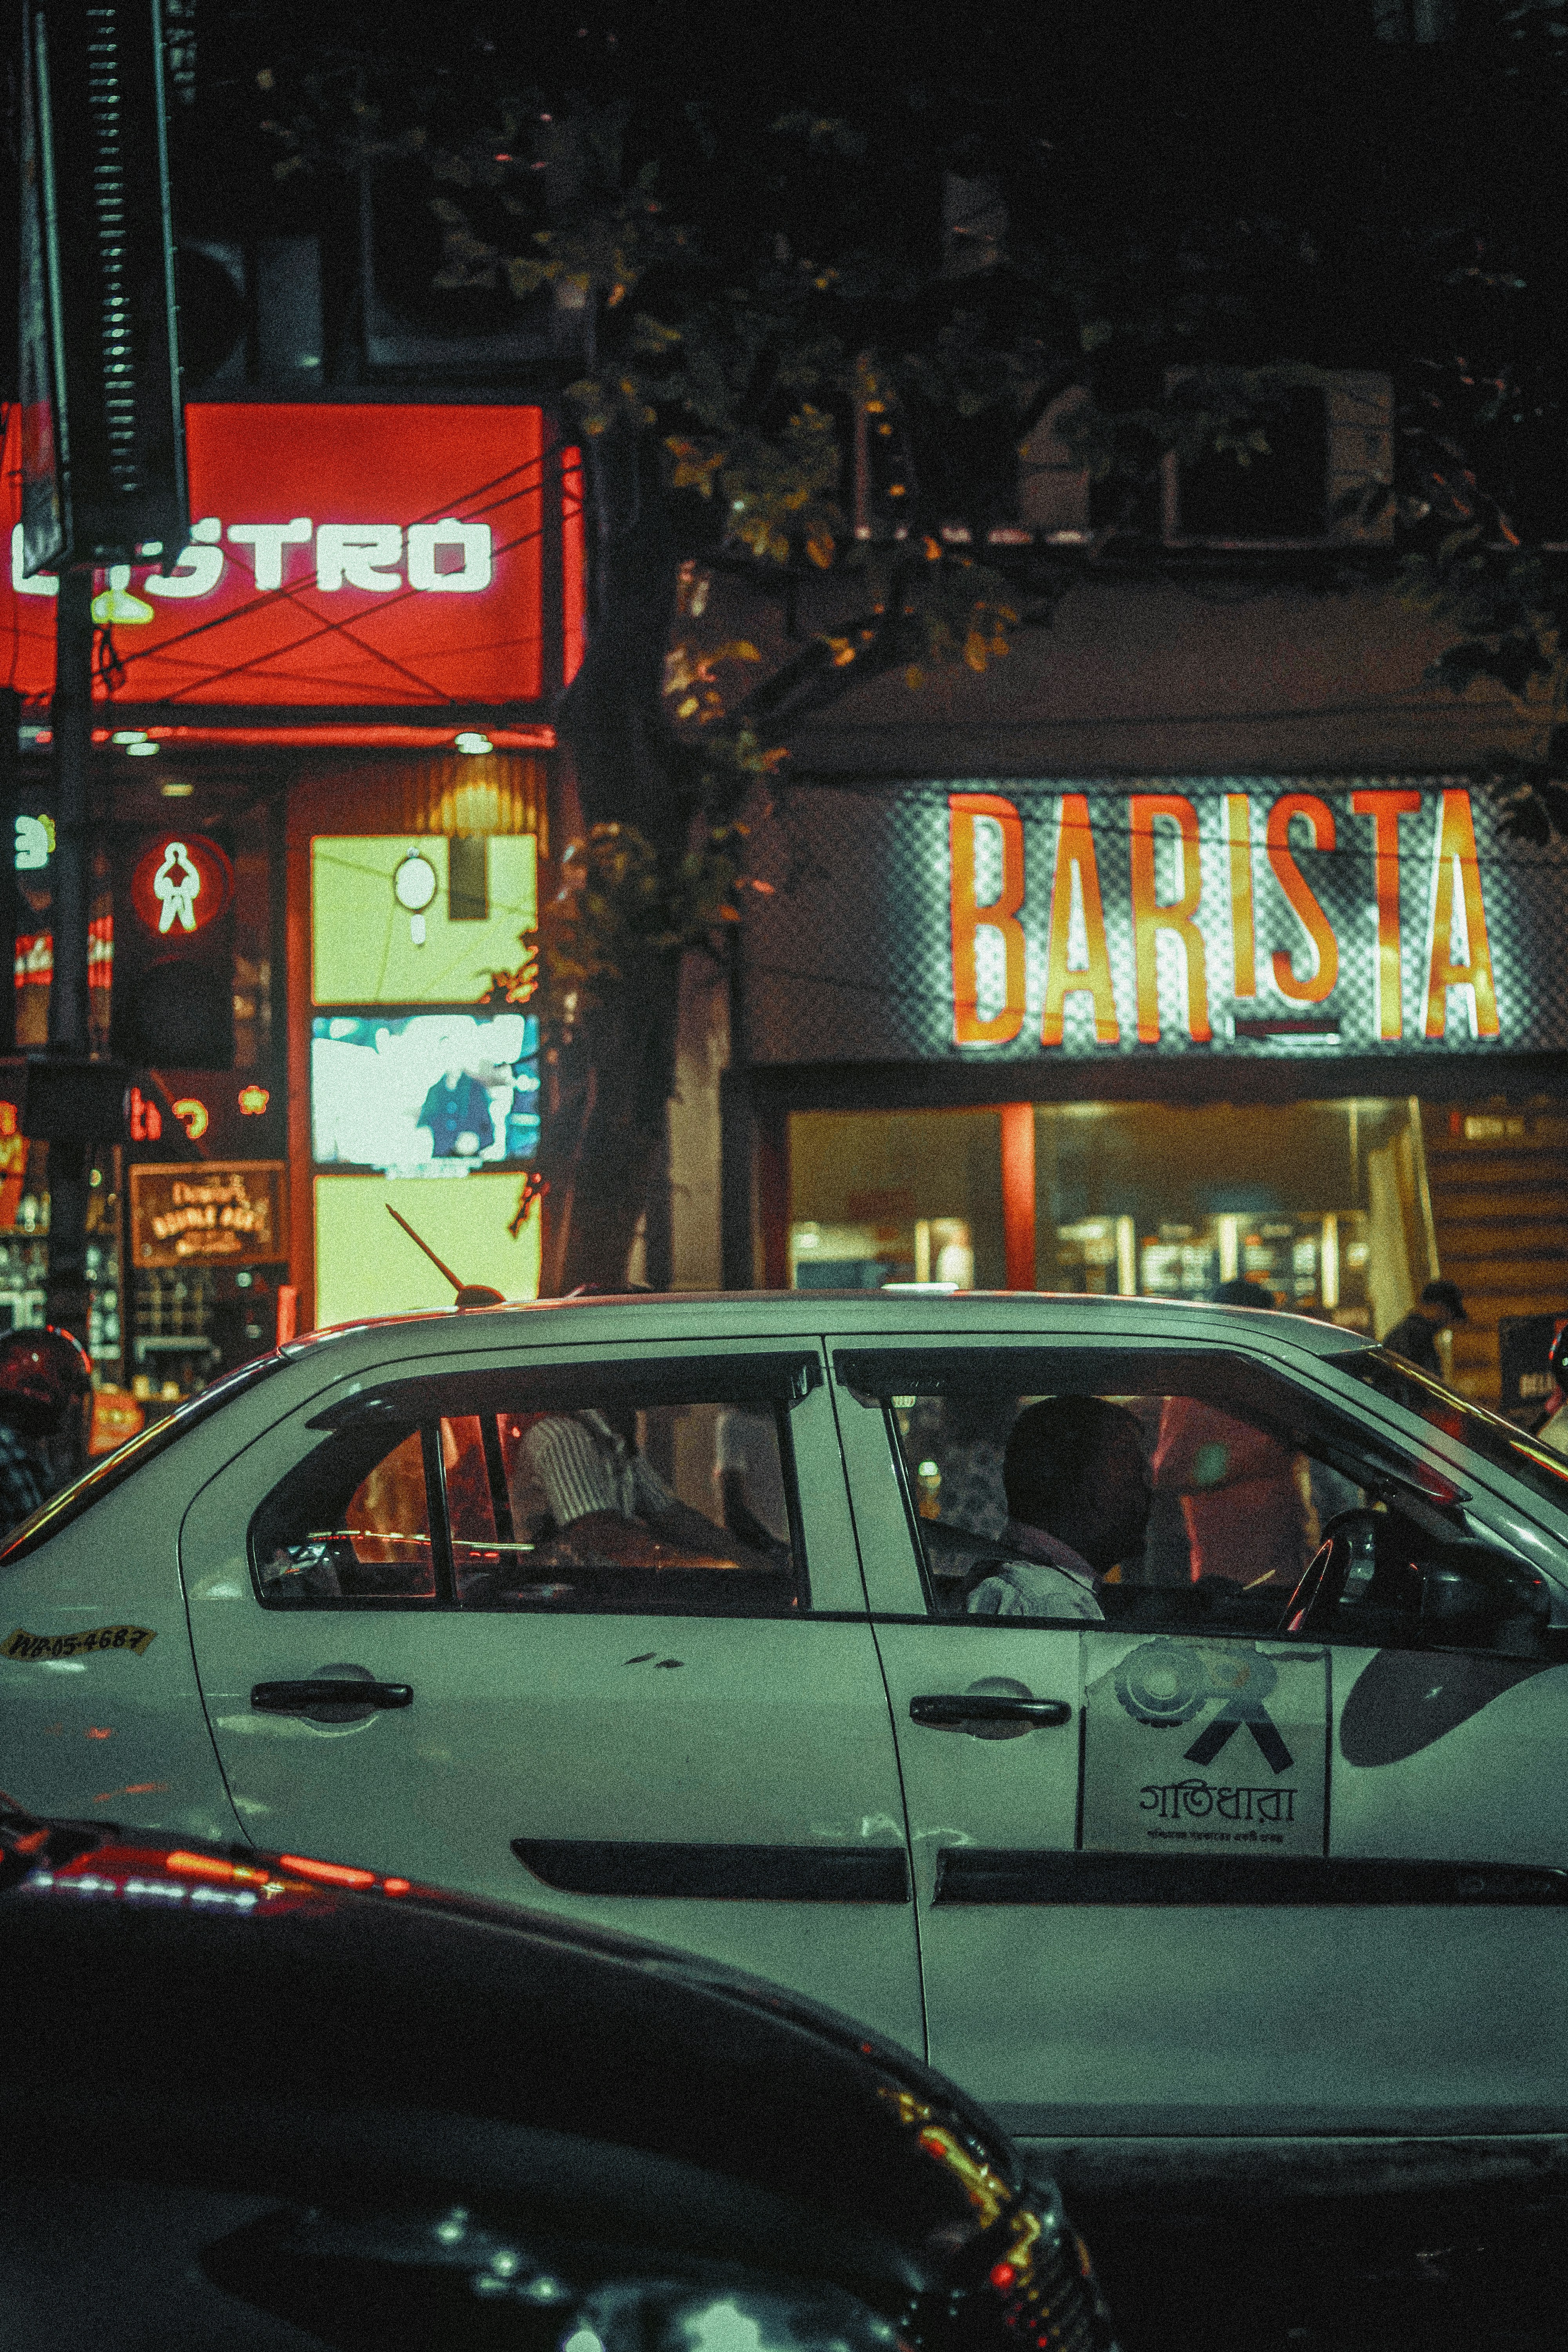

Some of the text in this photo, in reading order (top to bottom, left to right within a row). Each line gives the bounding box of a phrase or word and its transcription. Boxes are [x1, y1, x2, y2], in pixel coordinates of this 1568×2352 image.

[11, 517, 493, 598] STRO
[949, 789, 1500, 1044] BARISTA
[1139, 1779, 1298, 1823] গতিধারা
